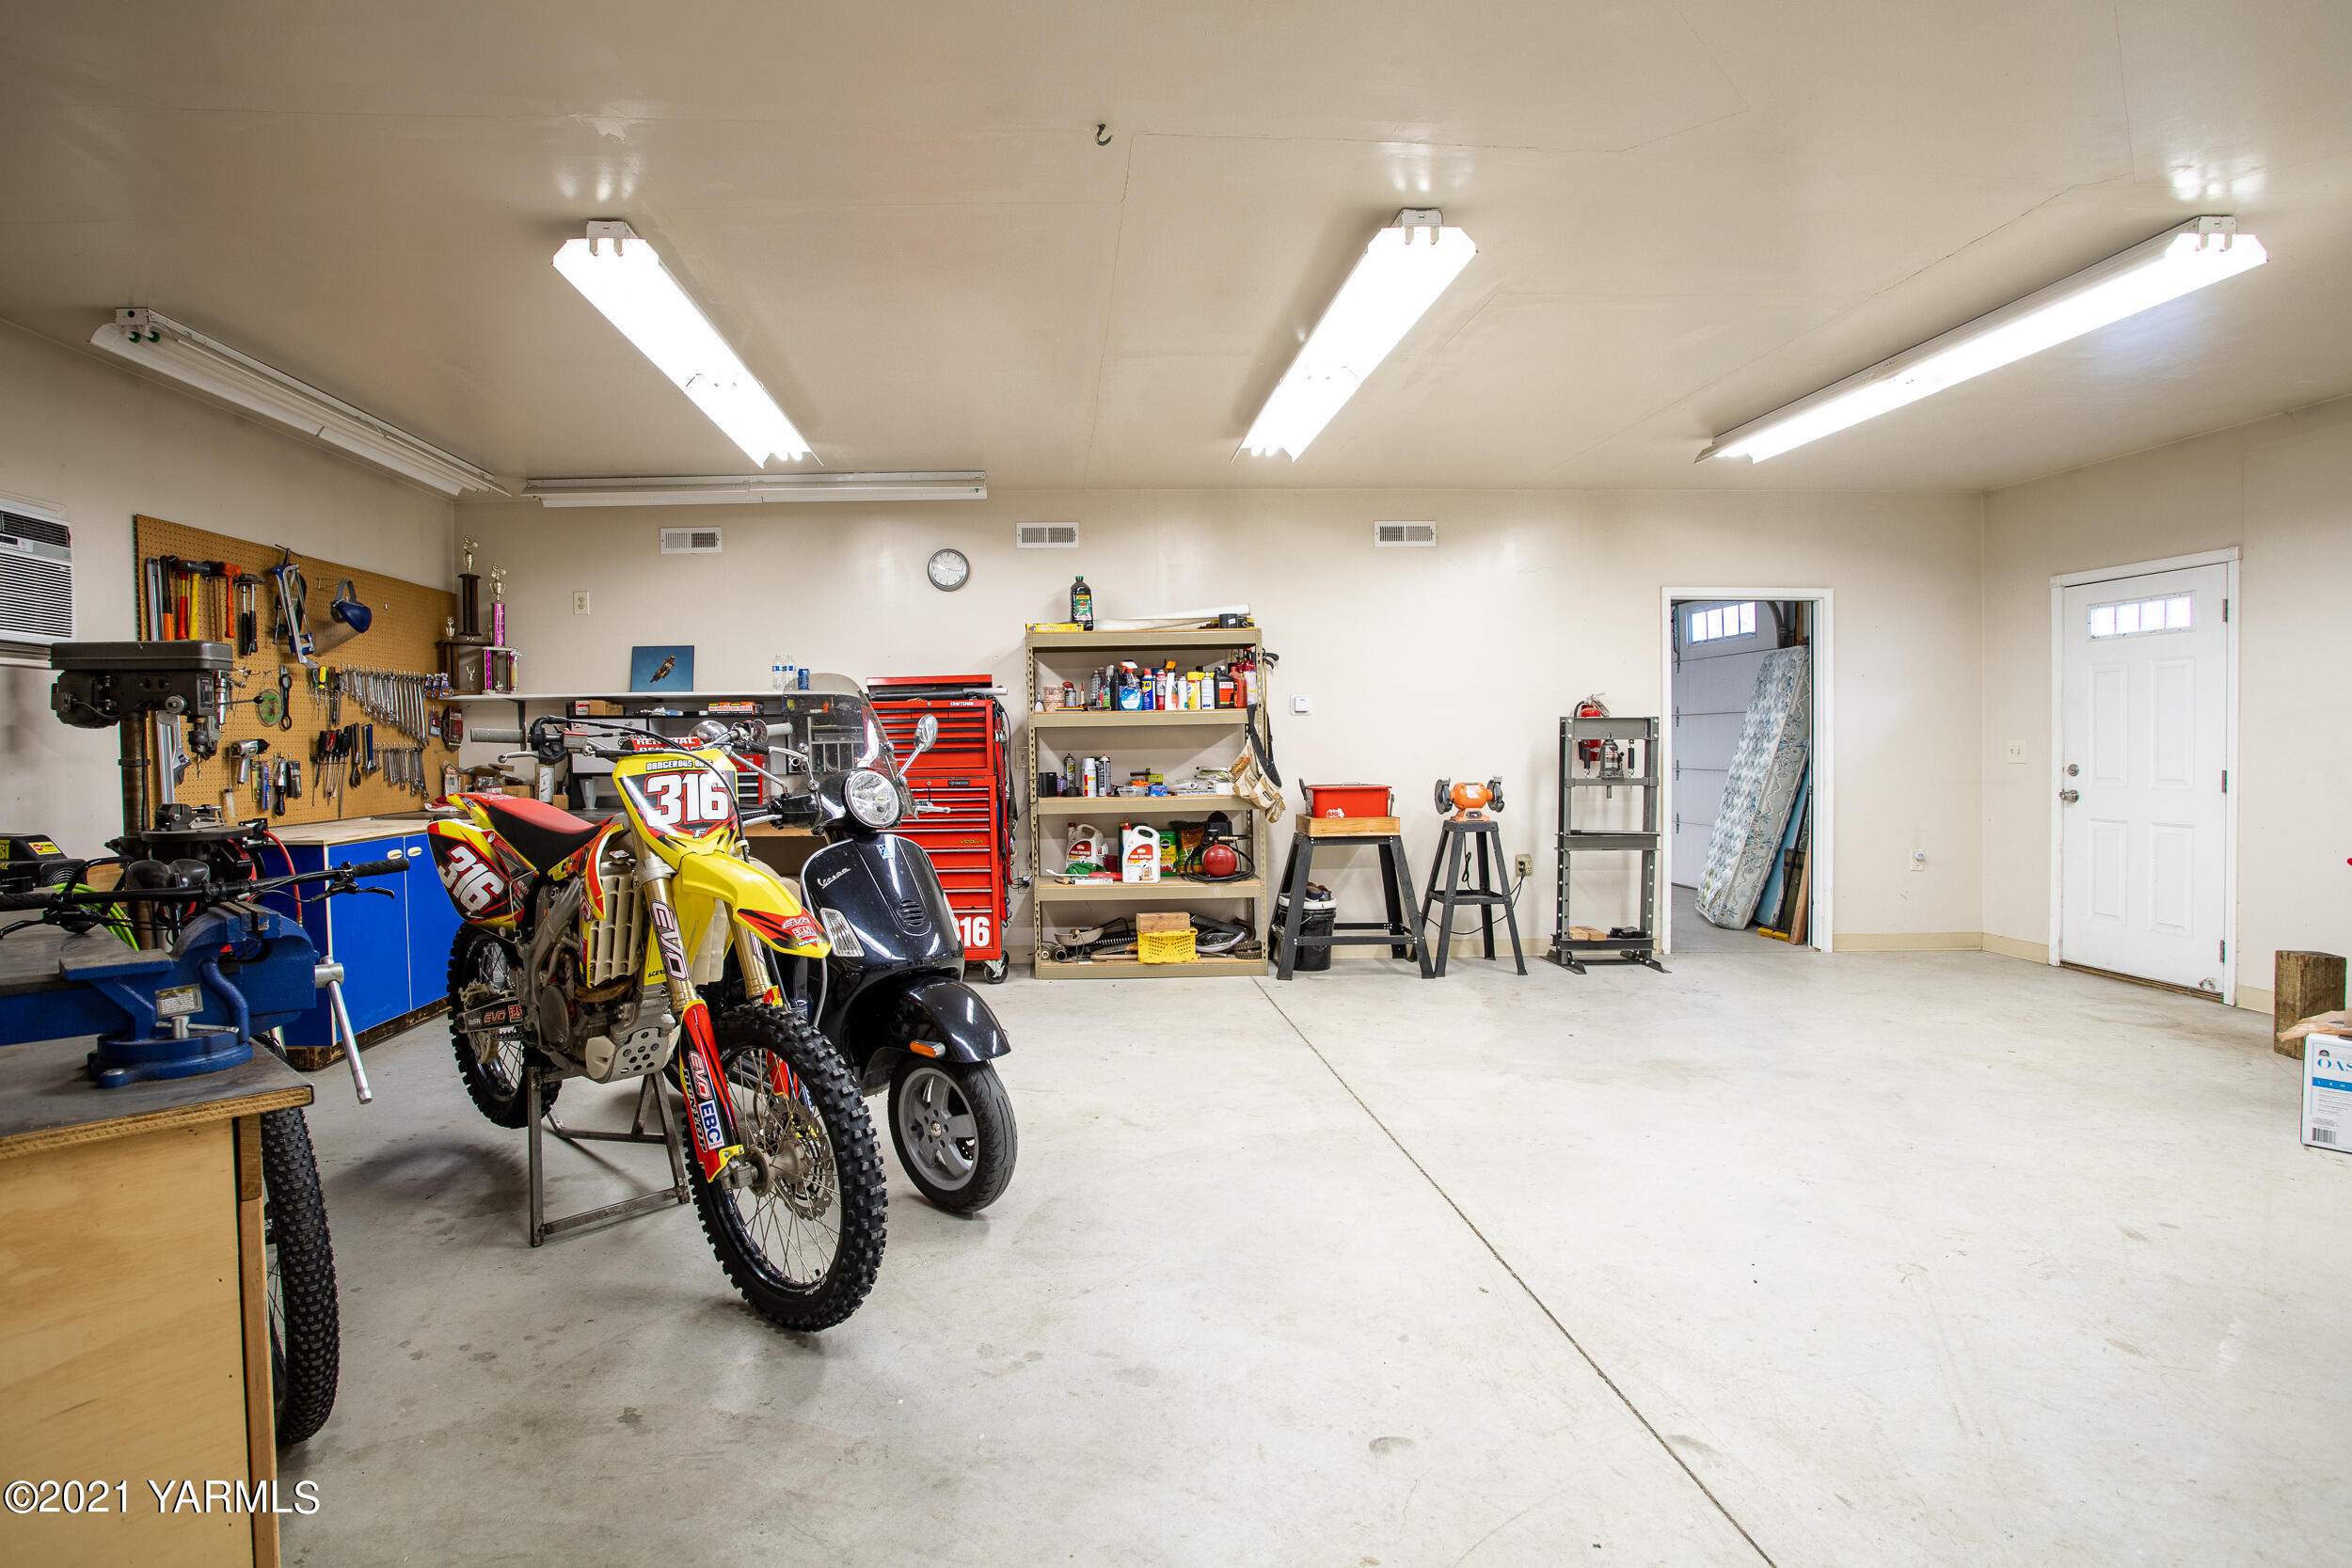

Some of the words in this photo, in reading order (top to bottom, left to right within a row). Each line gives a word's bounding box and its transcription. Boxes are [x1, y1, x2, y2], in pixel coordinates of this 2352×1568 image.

[636, 736, 696, 745] RENAL
[646, 759, 693, 771] DANGEROUS
[646, 772, 729, 827] 316
[437, 845, 505, 912] 316
[817, 867, 851, 890] Vespa
[782, 916, 811, 929] EVO
[954, 916, 991, 948] 16
[651, 900, 689, 980] EVO
[483, 1009, 506, 1024] EVO
[689, 1051, 712, 1100] EVO
[700, 1102, 722, 1144] EBC
